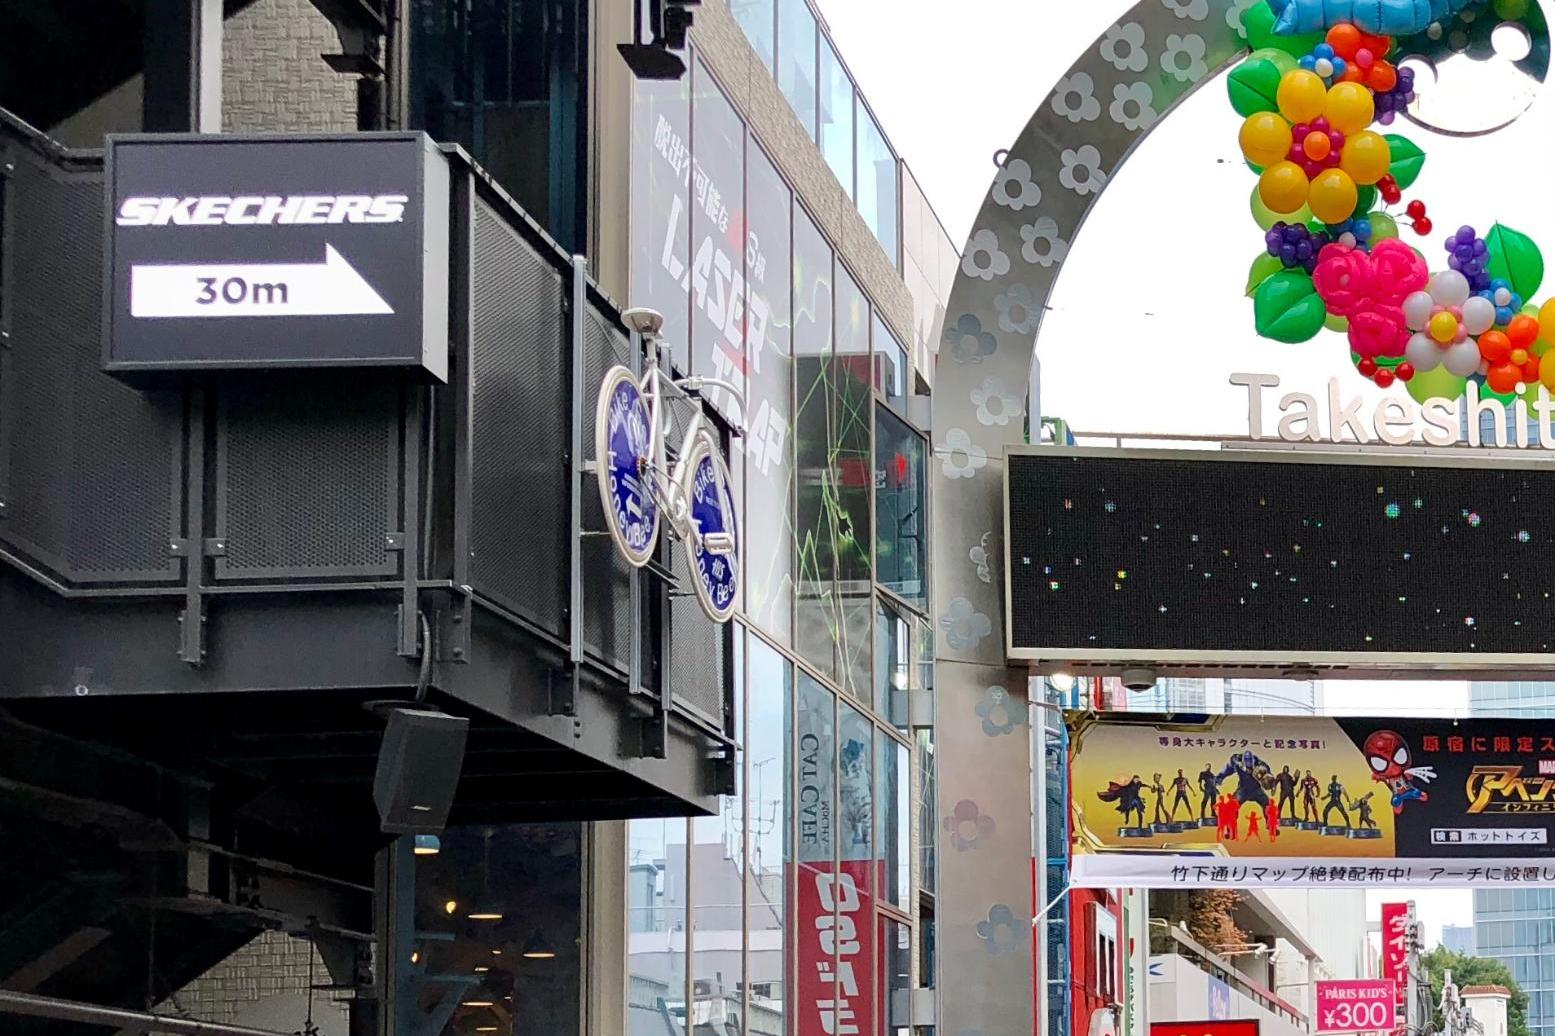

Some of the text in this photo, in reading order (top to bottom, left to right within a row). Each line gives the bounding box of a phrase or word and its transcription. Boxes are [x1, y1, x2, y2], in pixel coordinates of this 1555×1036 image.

[116, 195, 408, 226] SKECHERS
[196, 277, 289, 304] 30m
[662, 194, 769, 375] LASER
[1467, 831, 1541, 842] ホットトイズ
[1170, 865, 1412, 883] 竹下通りマップ絶賛配布中!
[1324, 986, 1388, 1000] PARIS KID'S
[1324, 1002, 1388, 1028] ¥300
